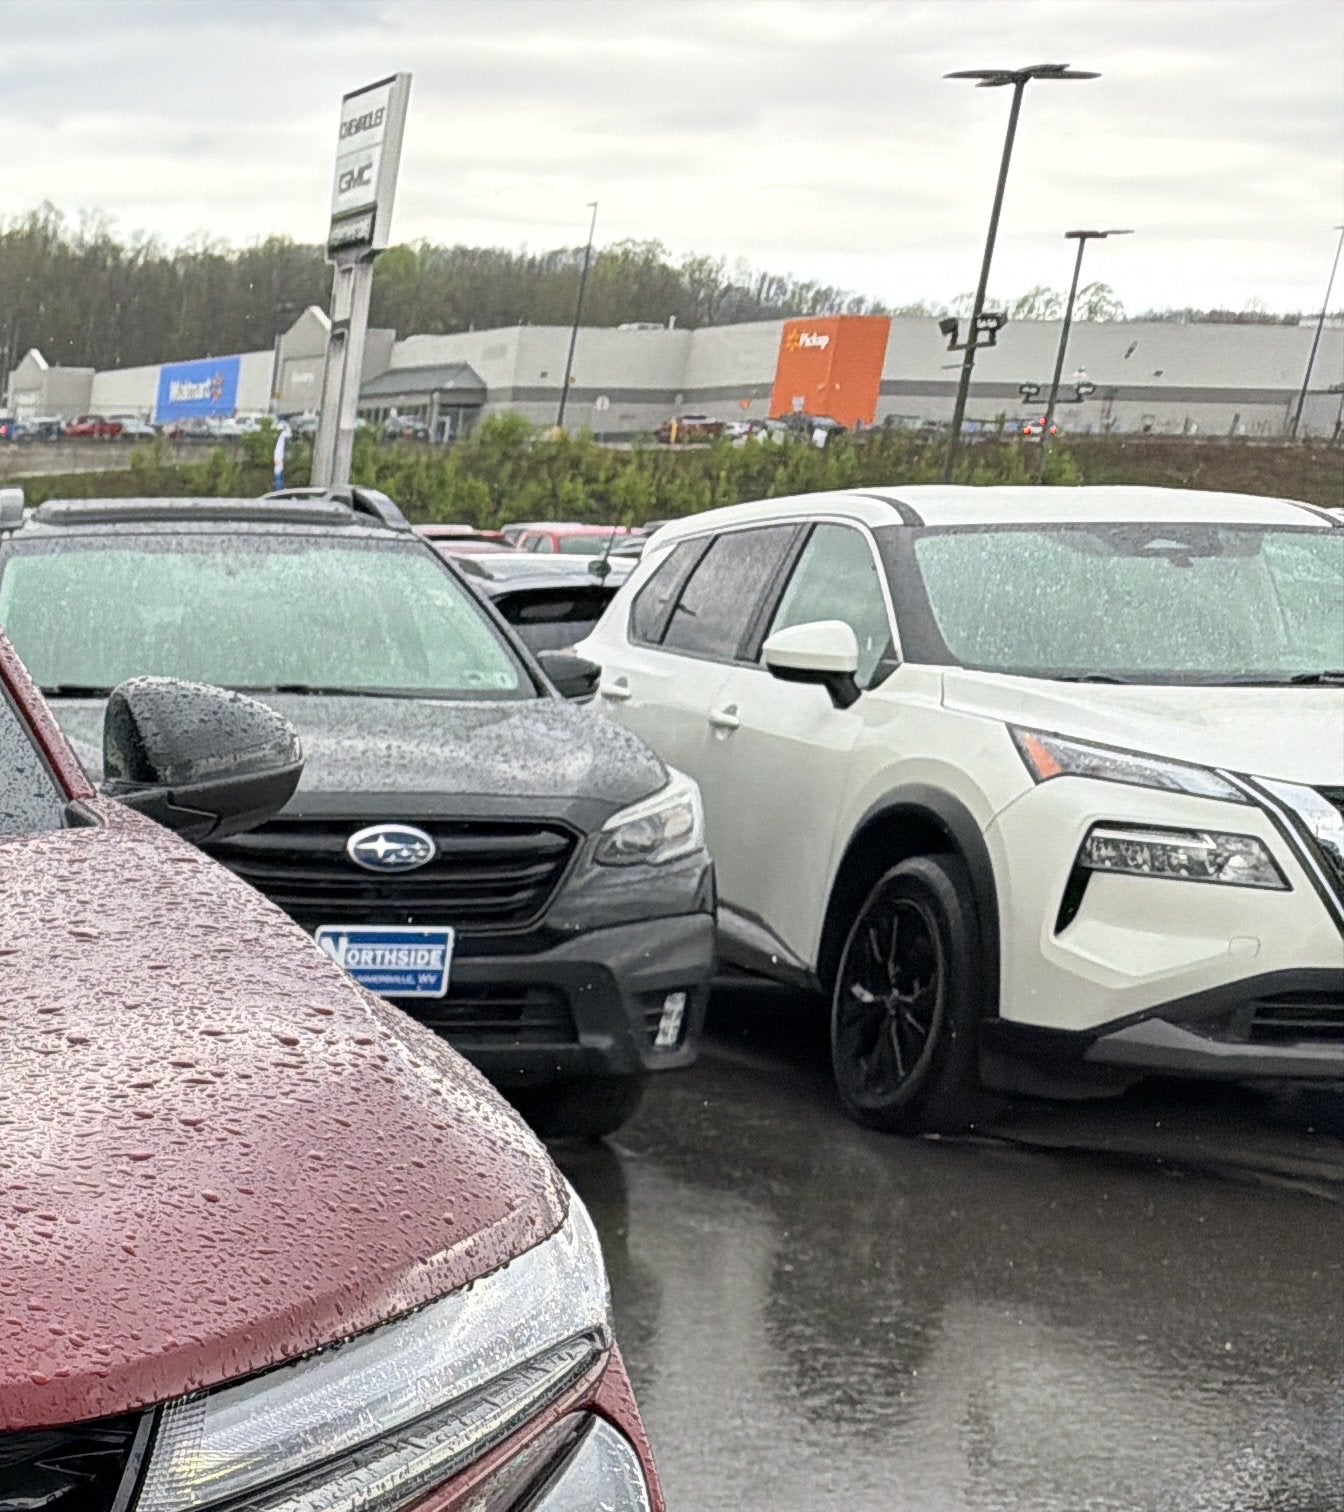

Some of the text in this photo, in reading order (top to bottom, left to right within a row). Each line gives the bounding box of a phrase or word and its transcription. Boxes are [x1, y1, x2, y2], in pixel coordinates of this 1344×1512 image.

[338, 162, 373, 194] GMC
[798, 331, 830, 351] Pickup
[320, 936, 443, 967] NORTHSIDE
